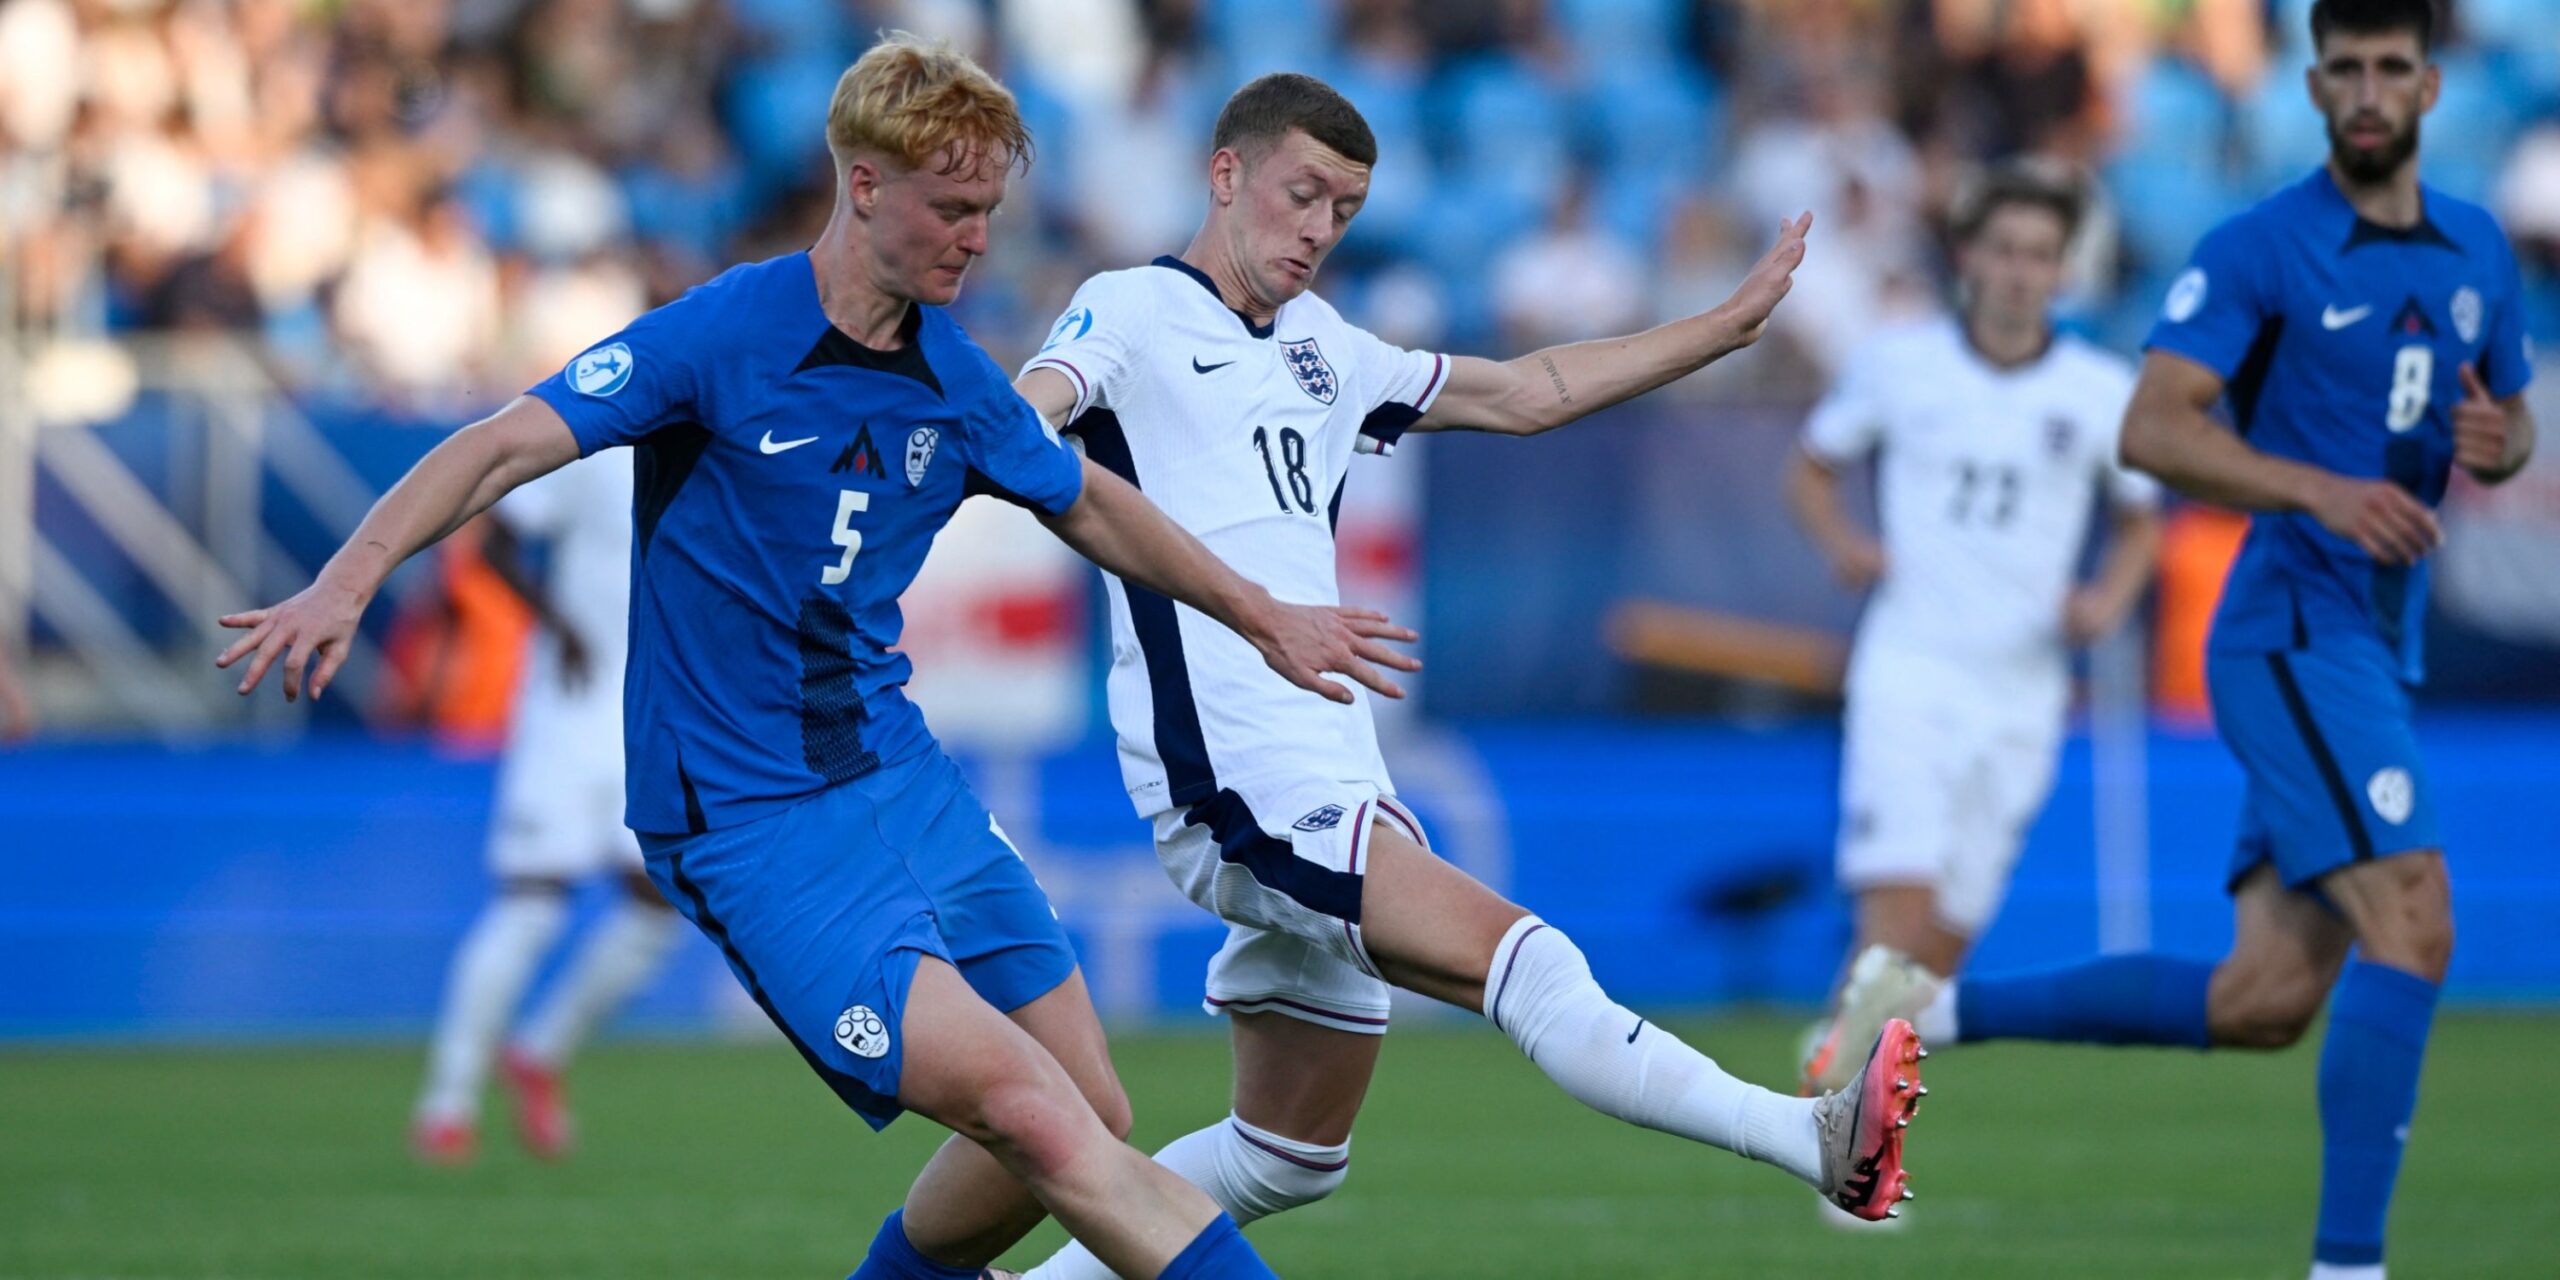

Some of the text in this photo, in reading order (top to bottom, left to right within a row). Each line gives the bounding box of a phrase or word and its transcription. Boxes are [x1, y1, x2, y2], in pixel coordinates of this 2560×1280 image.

[2385, 345, 2434, 433] 8
[1252, 425, 1319, 517] 18
[820, 489, 870, 585] 5
